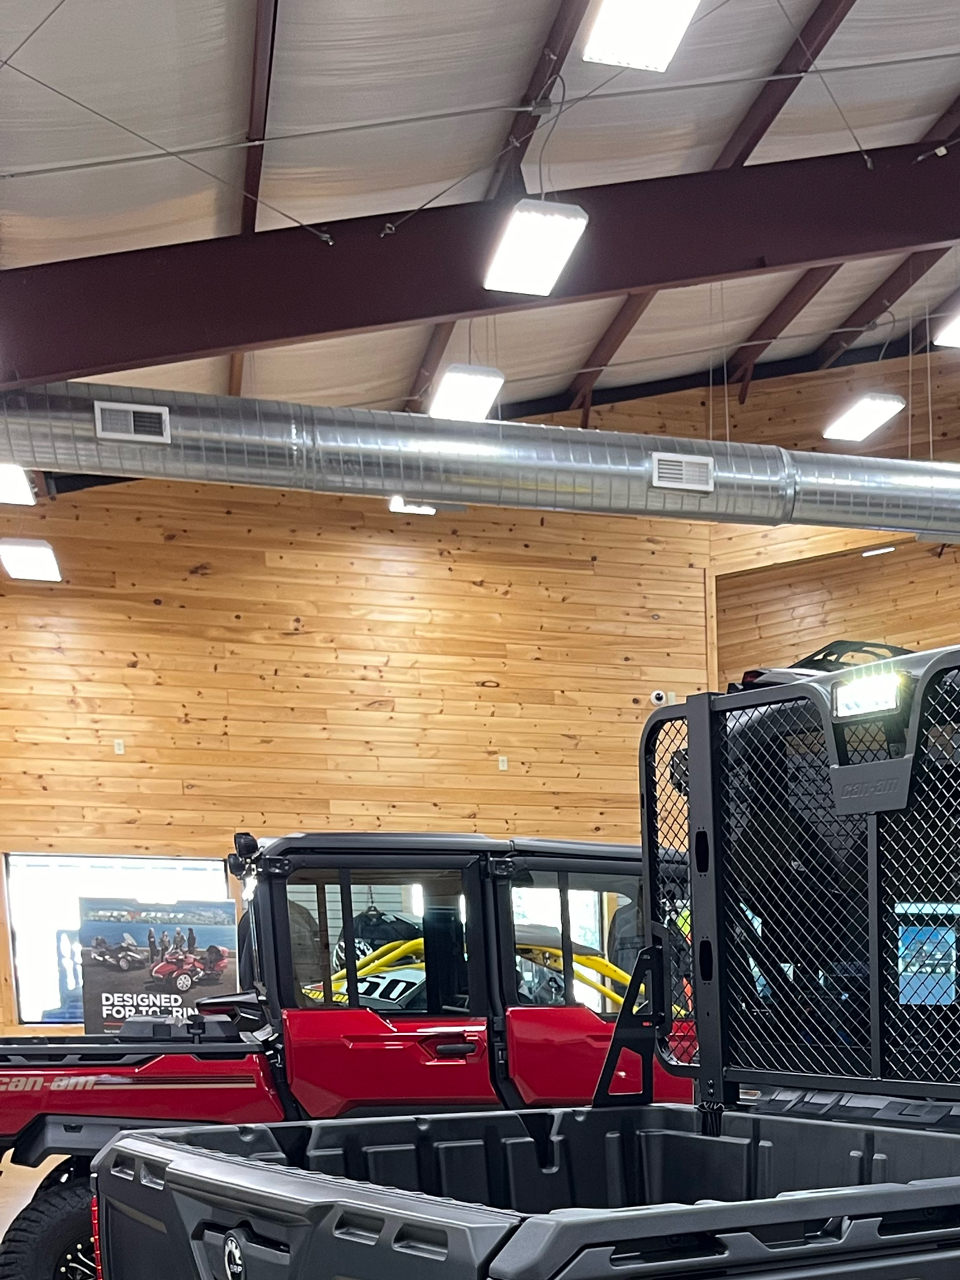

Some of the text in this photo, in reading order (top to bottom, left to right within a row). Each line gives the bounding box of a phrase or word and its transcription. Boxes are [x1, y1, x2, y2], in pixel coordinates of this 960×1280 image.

[101, 993, 182, 1006] DESIGNED
[102, 1006, 199, 1018] FOR TORIN
